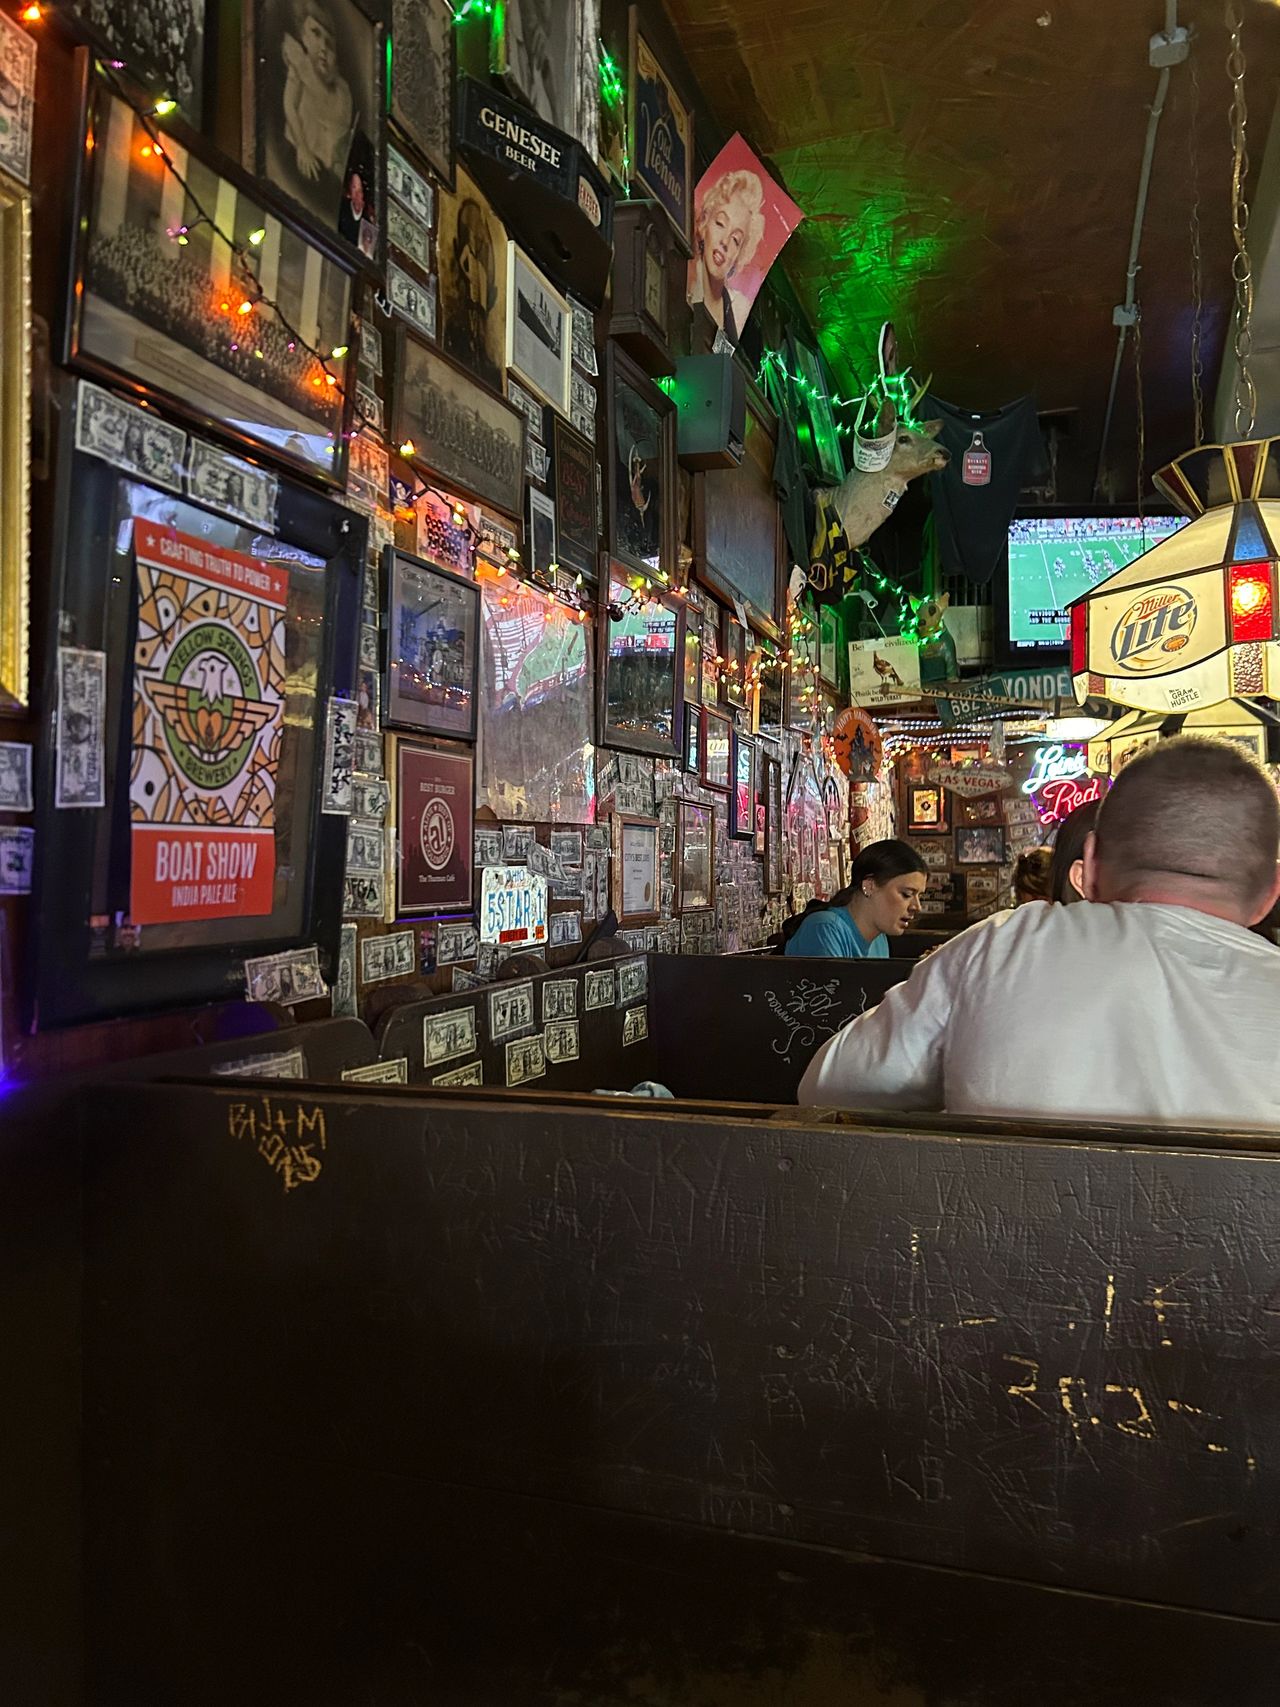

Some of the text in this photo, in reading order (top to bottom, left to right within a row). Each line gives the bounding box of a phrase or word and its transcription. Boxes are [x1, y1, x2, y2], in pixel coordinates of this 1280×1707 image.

[480, 107, 561, 168] GENESEE
[641, 102, 682, 205] Vienna
[657, 129, 671, 164] Old
[506, 145, 536, 172] BEER
[160, 537, 271, 592] CRAFTING TRUTH TO POWER
[1132, 594, 1180, 617] Miller
[1117, 600, 1195, 661] Lite
[172, 629, 255, 688] YELLOW SPRINGS
[1170, 691, 1200, 708] HUSTLE
[185, 760, 233, 783] BREWERY
[420, 782, 456, 795] BEST BURGER
[938, 774, 959, 785] LAS
[963, 775, 1001, 789] VEGAS
[1040, 779, 1101, 824] Red
[155, 841, 257, 882] BOAT SHOW
[172, 882, 237, 908] INDIA PALE ALE
[487, 889, 532, 934] 5STAR
